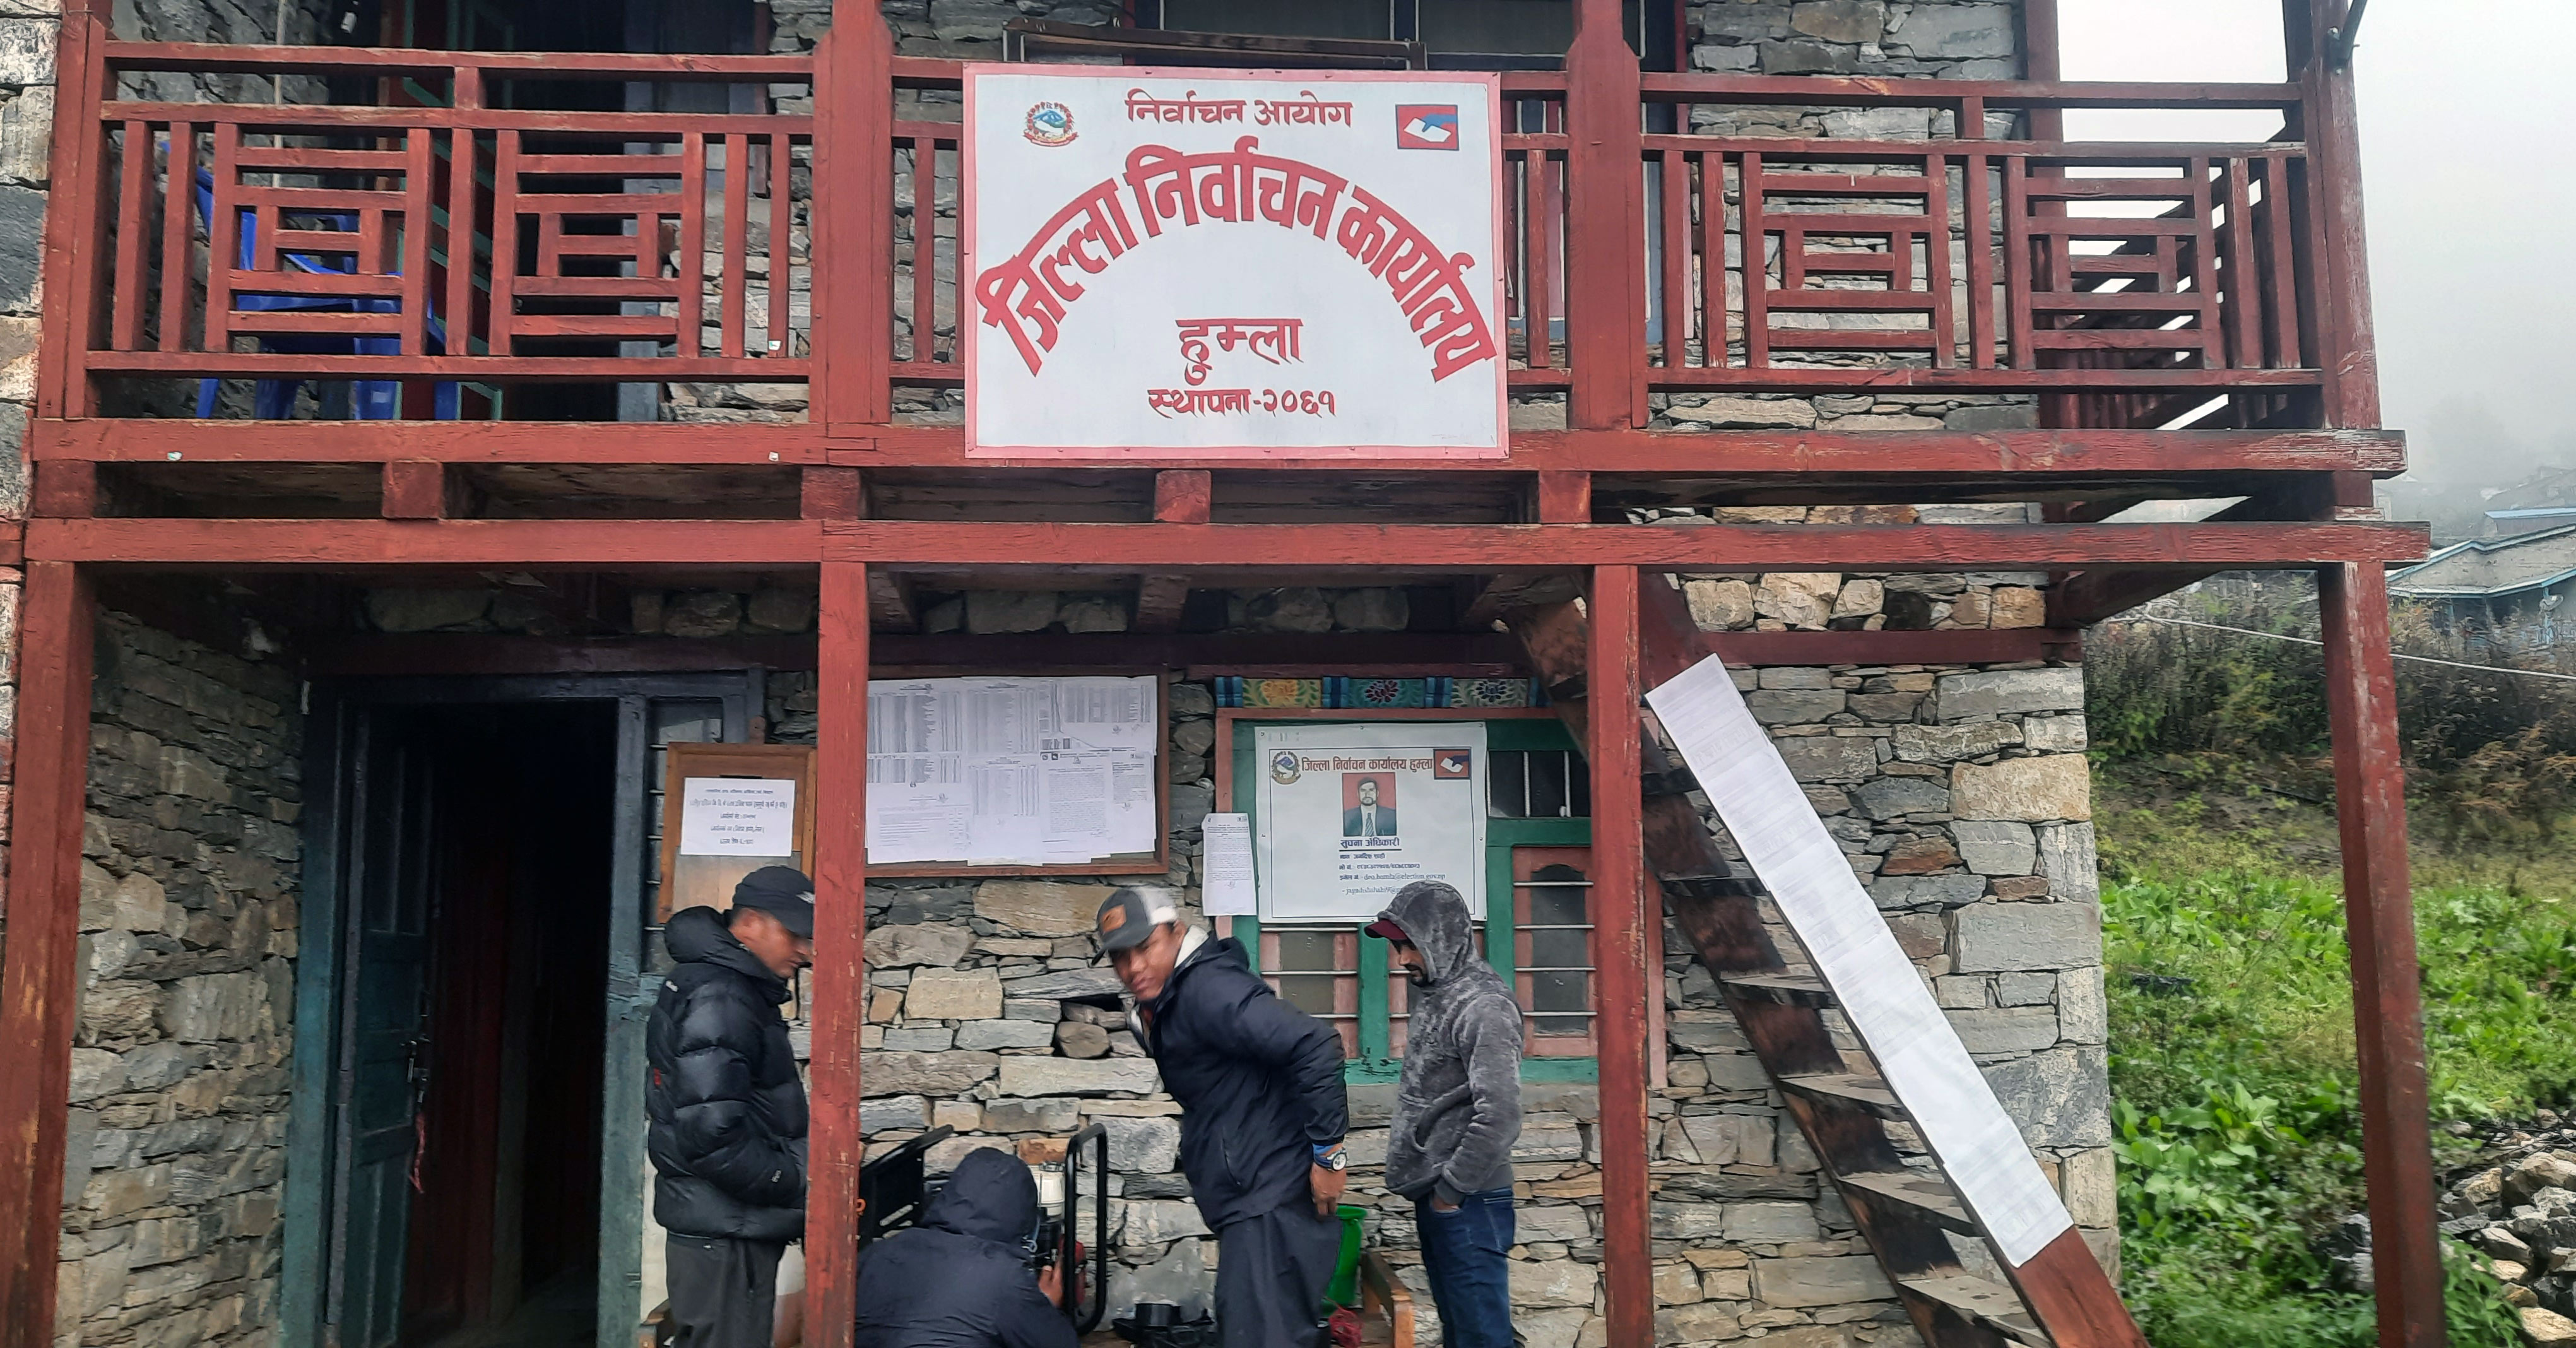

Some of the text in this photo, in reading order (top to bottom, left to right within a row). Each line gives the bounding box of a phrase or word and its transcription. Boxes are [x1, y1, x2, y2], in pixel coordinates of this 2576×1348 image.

[1125, 88, 1353, 128] निर्वाचन आयोग
[975, 135, 1498, 383] जिल्ला निर्वाचन कार्यालय
[1175, 317, 1304, 386] हुम्ला
[1301, 755, 1433, 772] जिल्ला निर्वाचन कार्यालय हुम्ला
